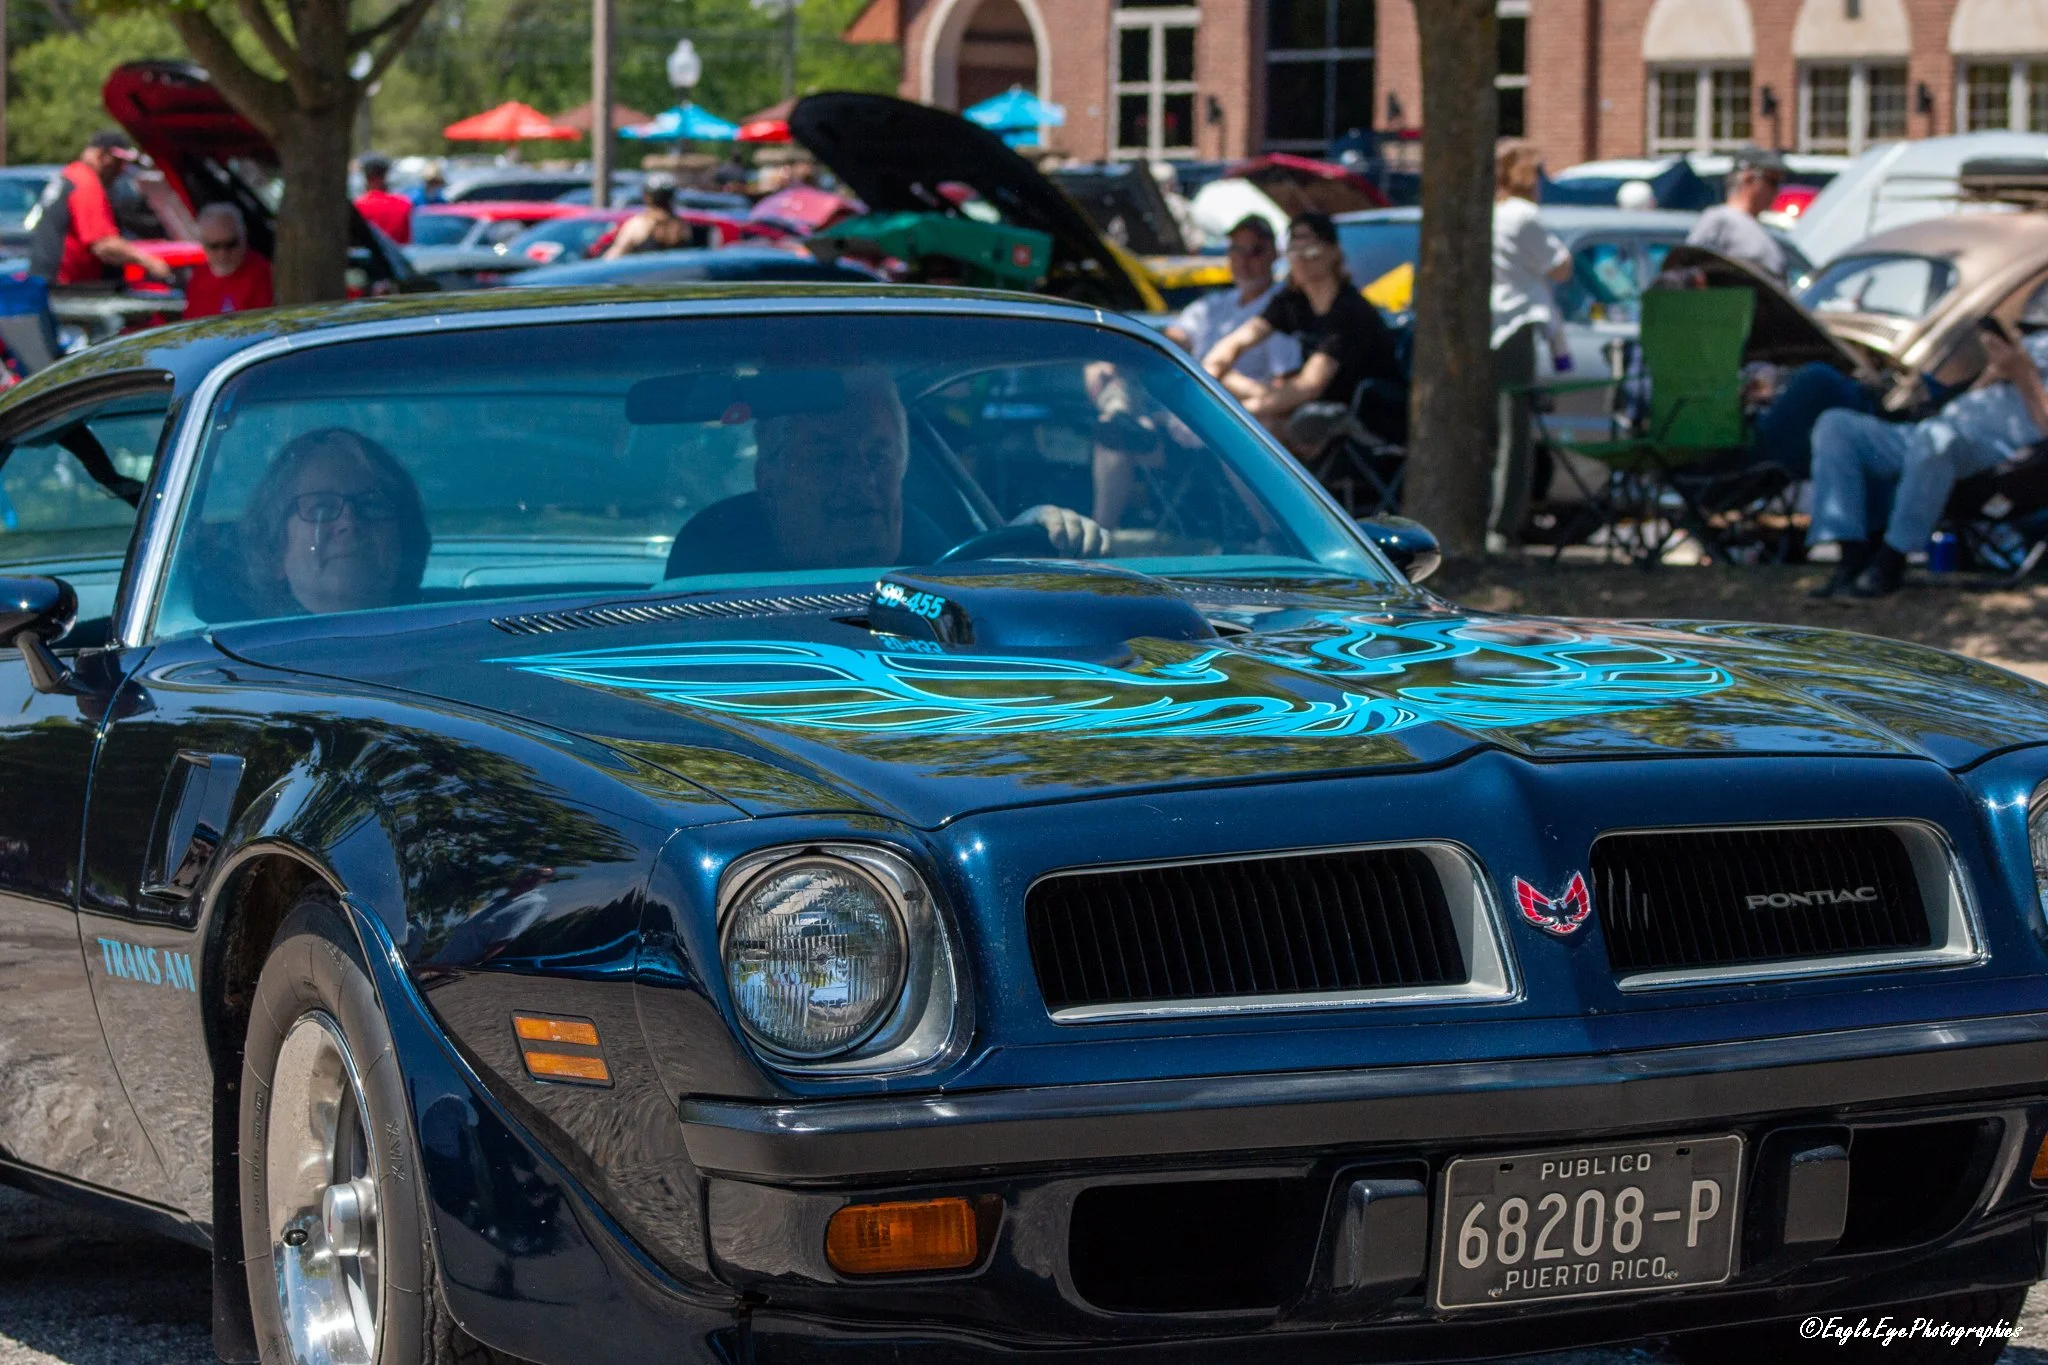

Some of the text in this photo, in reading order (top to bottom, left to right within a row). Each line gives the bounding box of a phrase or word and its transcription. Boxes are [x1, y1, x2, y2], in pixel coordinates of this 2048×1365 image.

[1745, 886, 1878, 909] PONTIAC
[97, 937, 196, 992] TRANS AM
[1541, 1153, 1651, 1180] PUBLICO
[1458, 1179, 1721, 1269] 68208-P
[1505, 1256, 1666, 1291] PUERTO RICO
